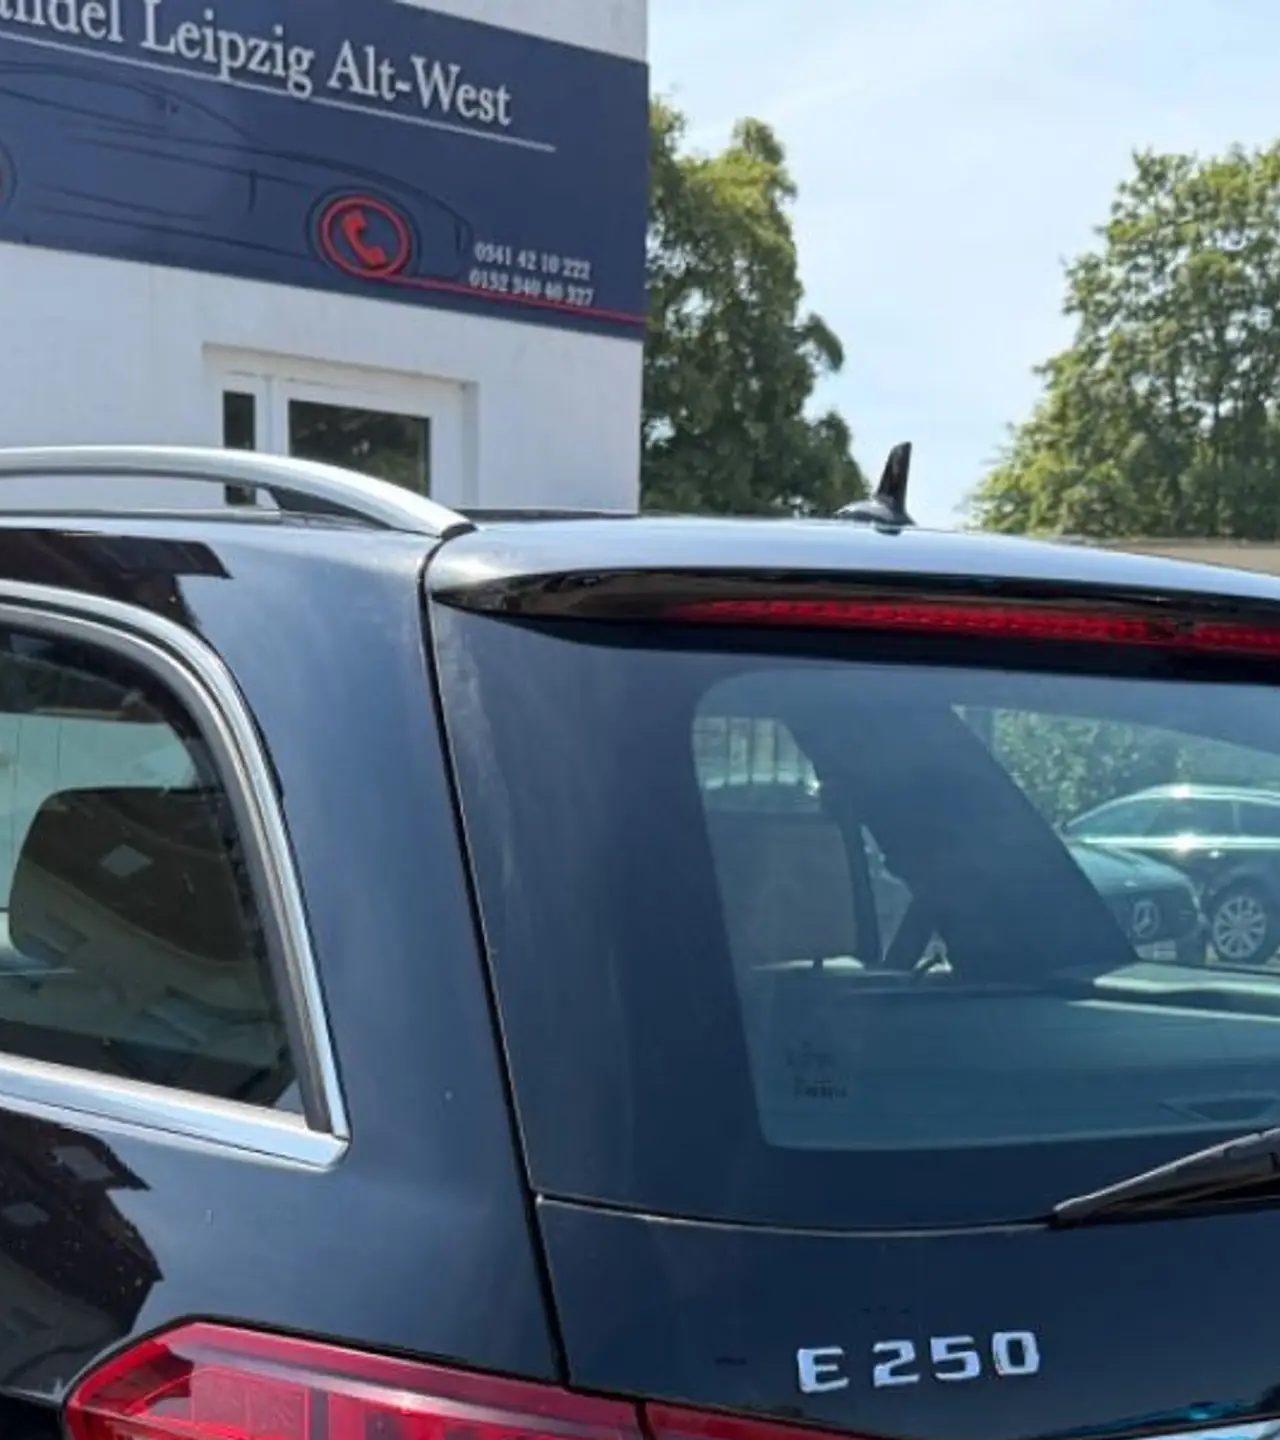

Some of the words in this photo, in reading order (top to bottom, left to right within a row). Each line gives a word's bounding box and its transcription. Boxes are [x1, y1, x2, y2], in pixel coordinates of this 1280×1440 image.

[140, 0, 314, 97] Leipzig
[326, 40, 512, 126] Alt-West
[796, 1346, 850, 1395] E
[872, 1331, 1042, 1389] 250
